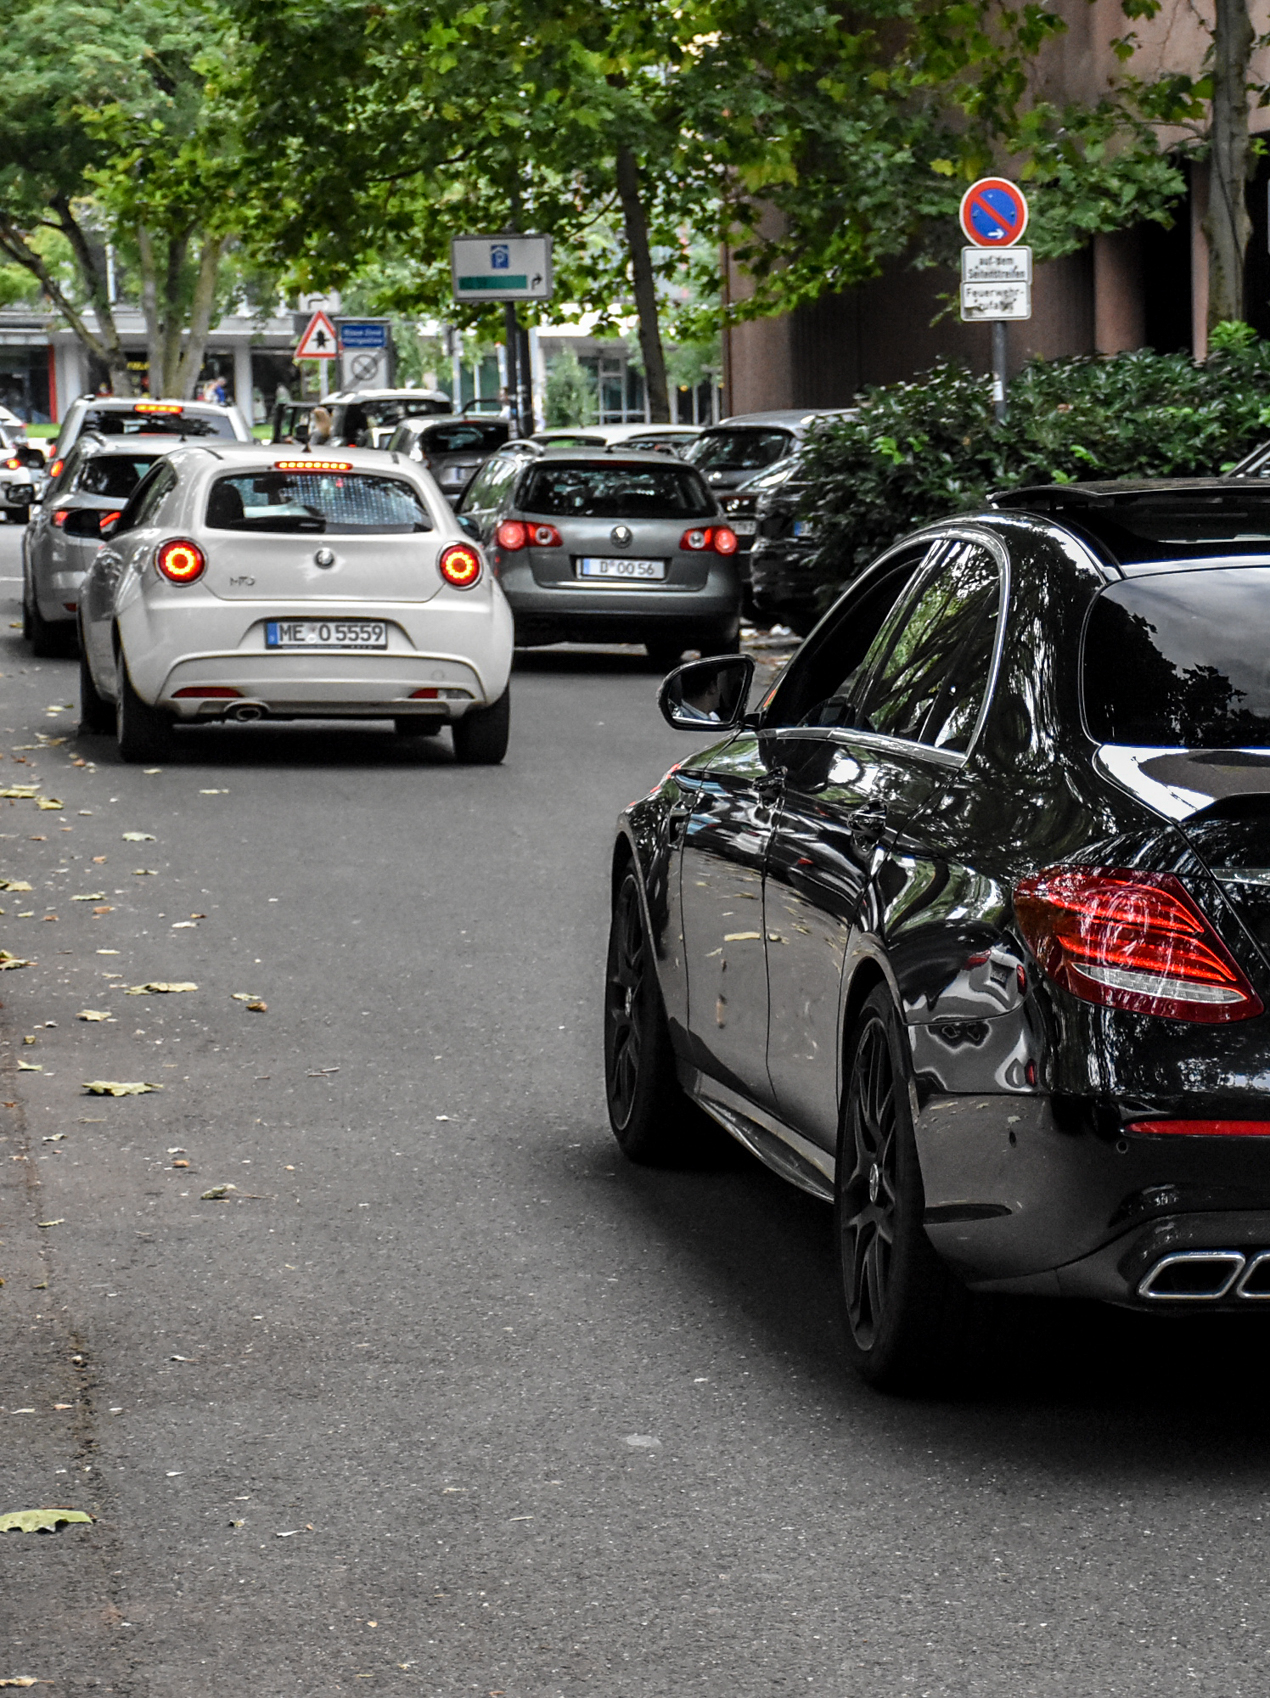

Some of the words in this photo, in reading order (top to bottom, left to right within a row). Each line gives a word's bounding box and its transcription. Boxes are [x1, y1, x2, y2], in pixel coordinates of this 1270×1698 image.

[969, 266, 1025, 278] Seitenstreifen
[638, 563, 654, 575] 56
[279, 624, 305, 642] ME
[335, 624, 383, 642] 5559
